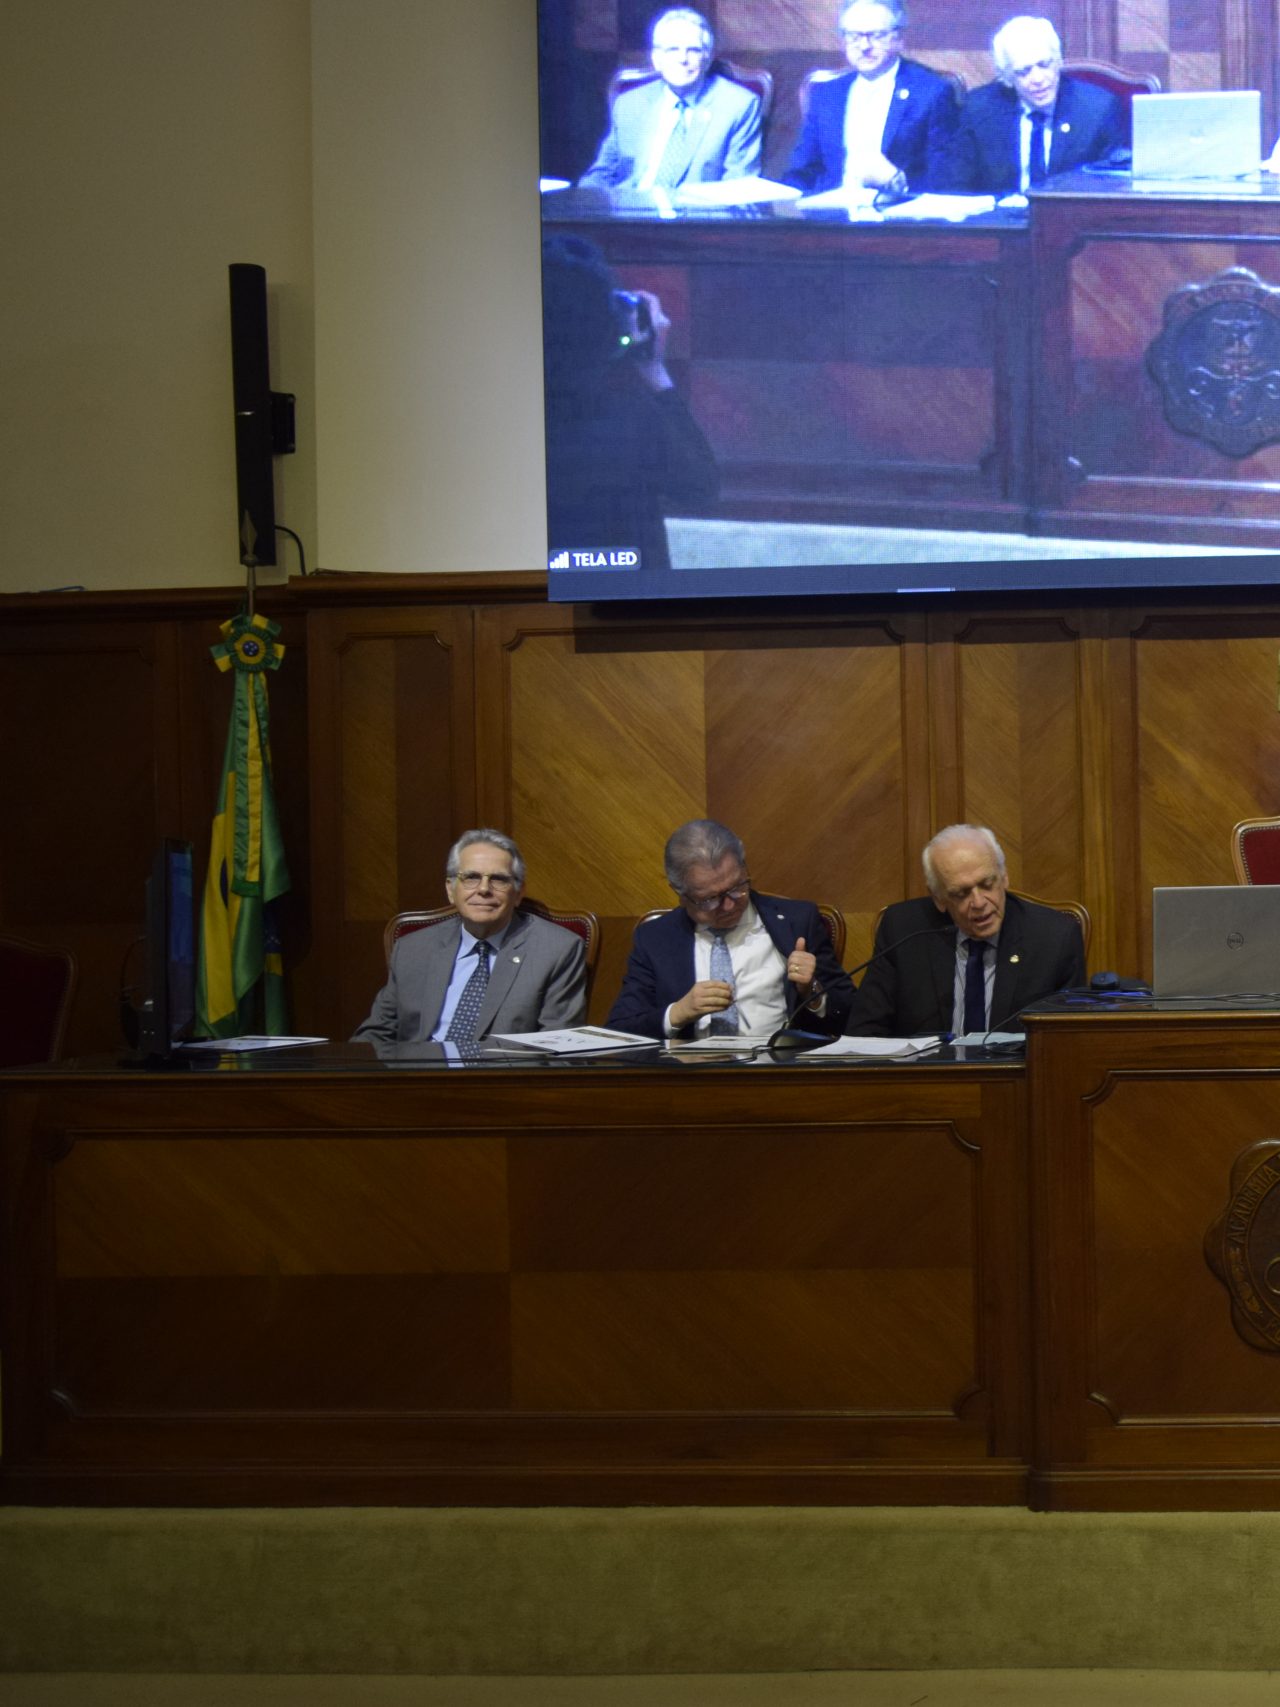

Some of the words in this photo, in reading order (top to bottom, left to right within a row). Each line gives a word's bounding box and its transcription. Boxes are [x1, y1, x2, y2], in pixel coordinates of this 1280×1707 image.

[572, 552, 607, 567] TELA
[610, 551, 637, 566] LED
[1227, 1166, 1280, 1244] ACADEMIA
